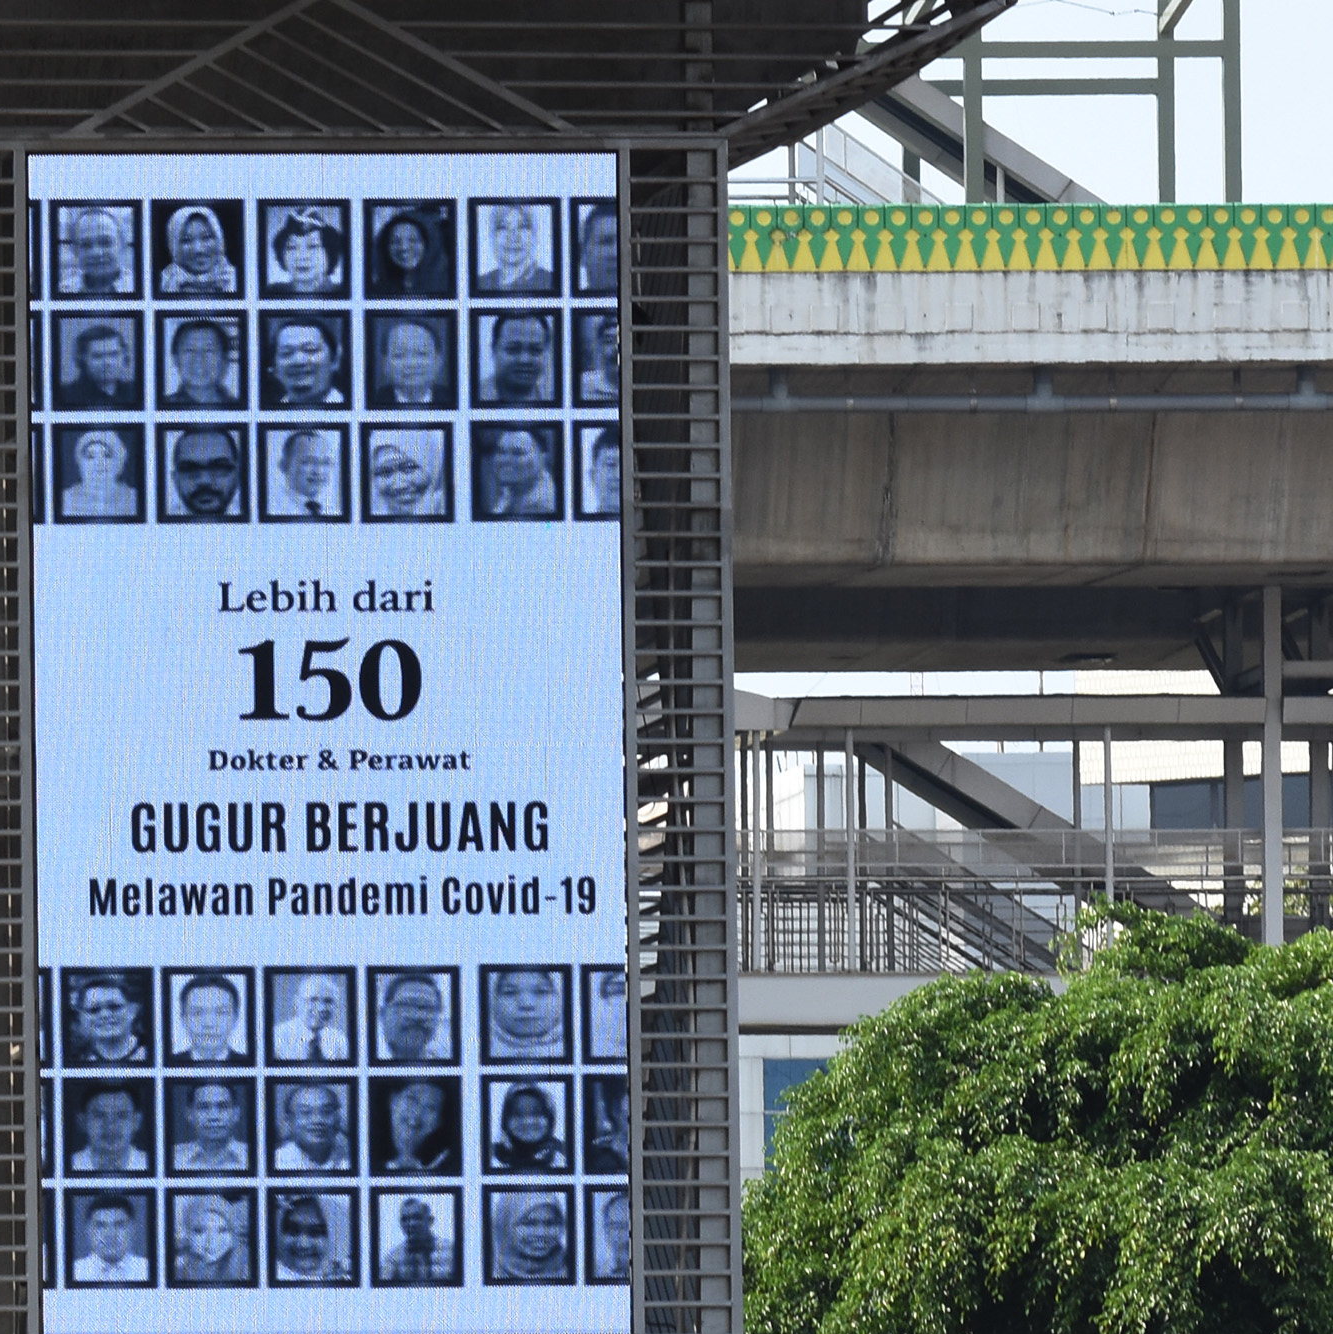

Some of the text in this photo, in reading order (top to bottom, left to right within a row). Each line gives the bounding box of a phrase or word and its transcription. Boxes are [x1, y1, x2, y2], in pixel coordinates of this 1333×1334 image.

[218, 579, 435, 614] Lebih dari
[237, 637, 423, 722] 150
[209, 748, 471, 772] Dokter & Perawat
[130, 800, 549, 854] GUGUR BERJUANG
[88, 874, 596, 917] Melawan Pandemi Covid-19
